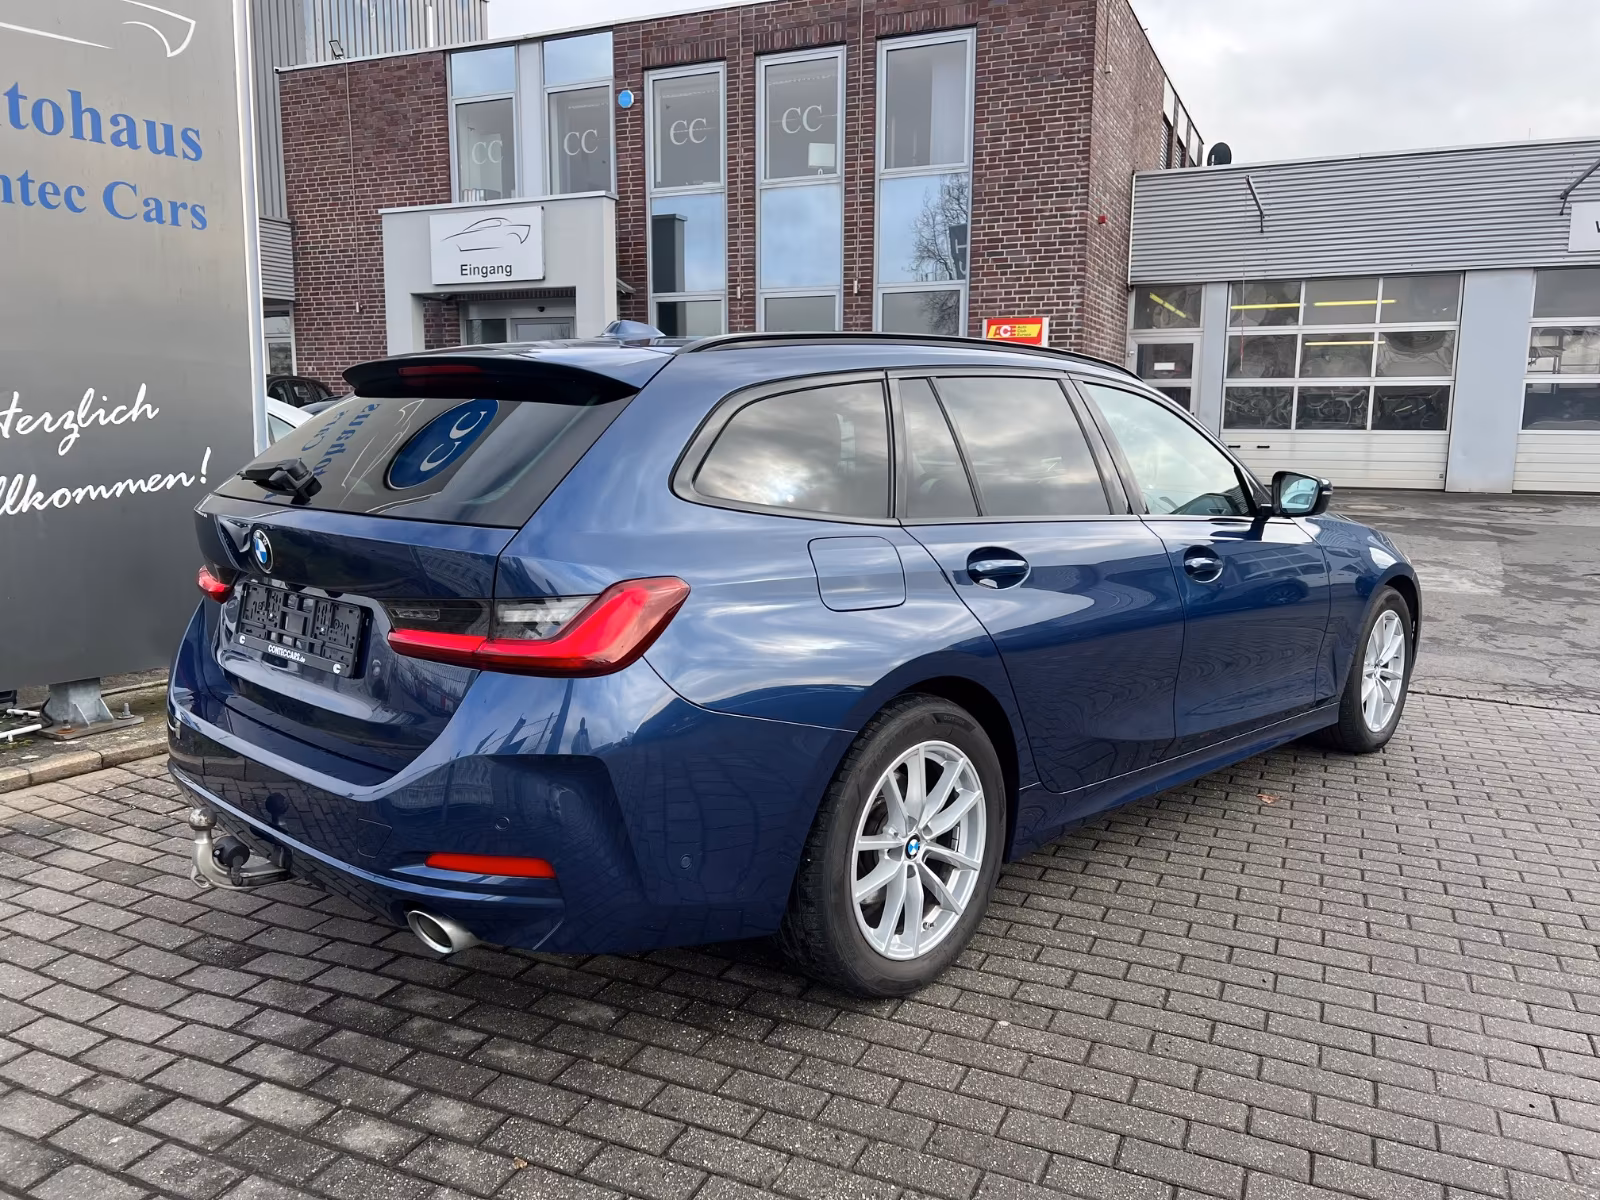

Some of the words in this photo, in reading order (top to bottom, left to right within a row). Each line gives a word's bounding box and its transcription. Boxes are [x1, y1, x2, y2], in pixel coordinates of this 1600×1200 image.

[0, 81, 203, 162] tohaus
[669, 117, 707, 145] CC
[781, 104, 823, 134] CC
[471, 139, 504, 165] CC
[563, 129, 598, 156] CC
[102, 180, 208, 231] Cars
[460, 263, 513, 278] Eingang
[993, 325, 1017, 337] ACE
